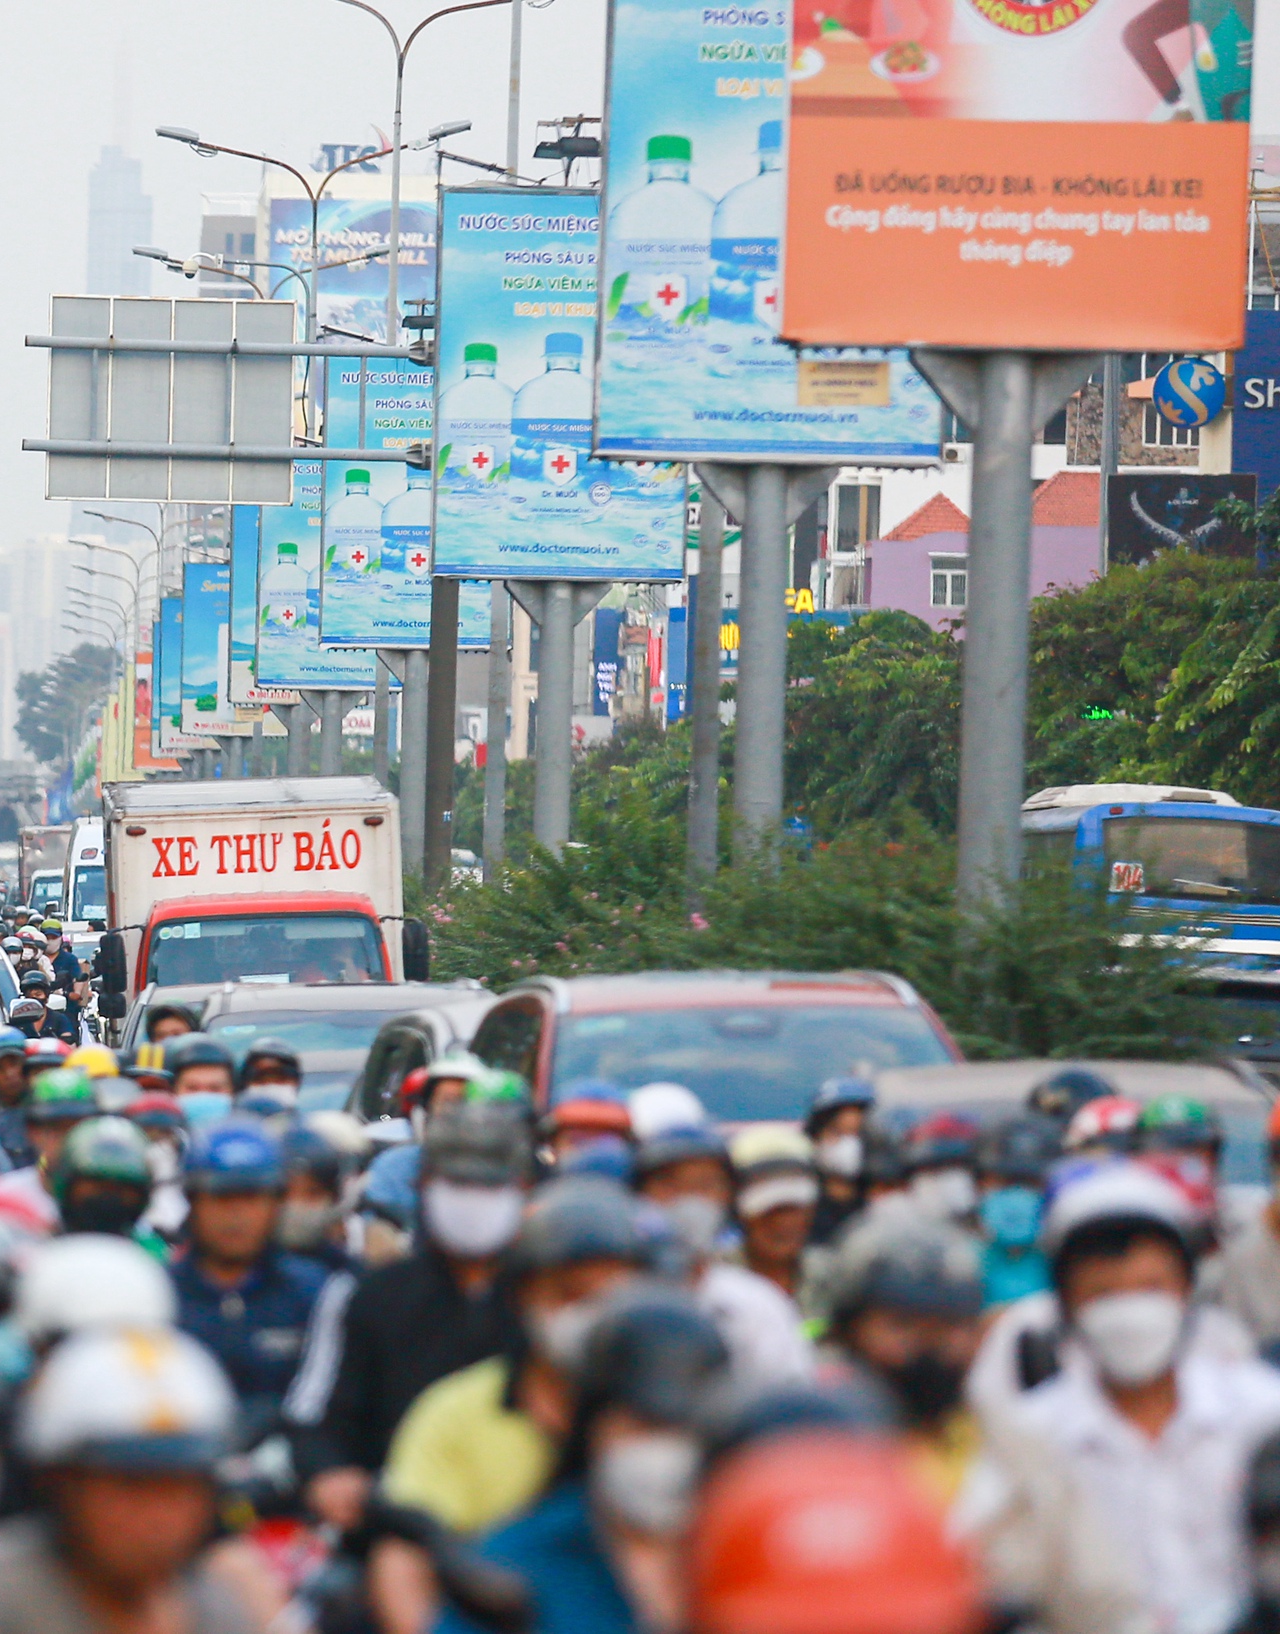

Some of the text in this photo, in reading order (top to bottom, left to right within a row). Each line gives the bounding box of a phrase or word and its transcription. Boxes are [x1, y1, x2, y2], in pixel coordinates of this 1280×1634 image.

[703, 5, 769, 26] PHÒNG
[716, 78, 759, 99] LOẠI
[871, 170, 931, 194] UỐNG
[1001, 176, 1032, 195] BIA
[1053, 174, 1128, 196] KHÔNG
[1133, 174, 1165, 197] LÁI
[460, 212, 507, 231] NƯỚC
[510, 213, 543, 231] SÚC
[825, 205, 881, 233] Cộng
[883, 204, 937, 233] đồng
[939, 206, 979, 233] hãy
[980, 207, 1032, 236] cùng
[1034, 207, 1100, 236] chung
[1102, 210, 1136, 236] tay
[1138, 209, 1171, 231] lan
[505, 248, 553, 265] PHÒNG
[557, 250, 584, 265] SÂU
[959, 238, 1073, 267] thông điệp
[503, 274, 544, 290] NGỪA
[548, 275, 582, 290] VIÊM
[514, 302, 546, 317] LOẠI
[547, 302, 563, 317] VI
[381, 371, 405, 384] SÚC
[375, 398, 412, 409] PHÒNG
[498, 542, 620, 555] www.doctormuoi.vn
[152, 817, 362, 877] XE THƯ BÁO
